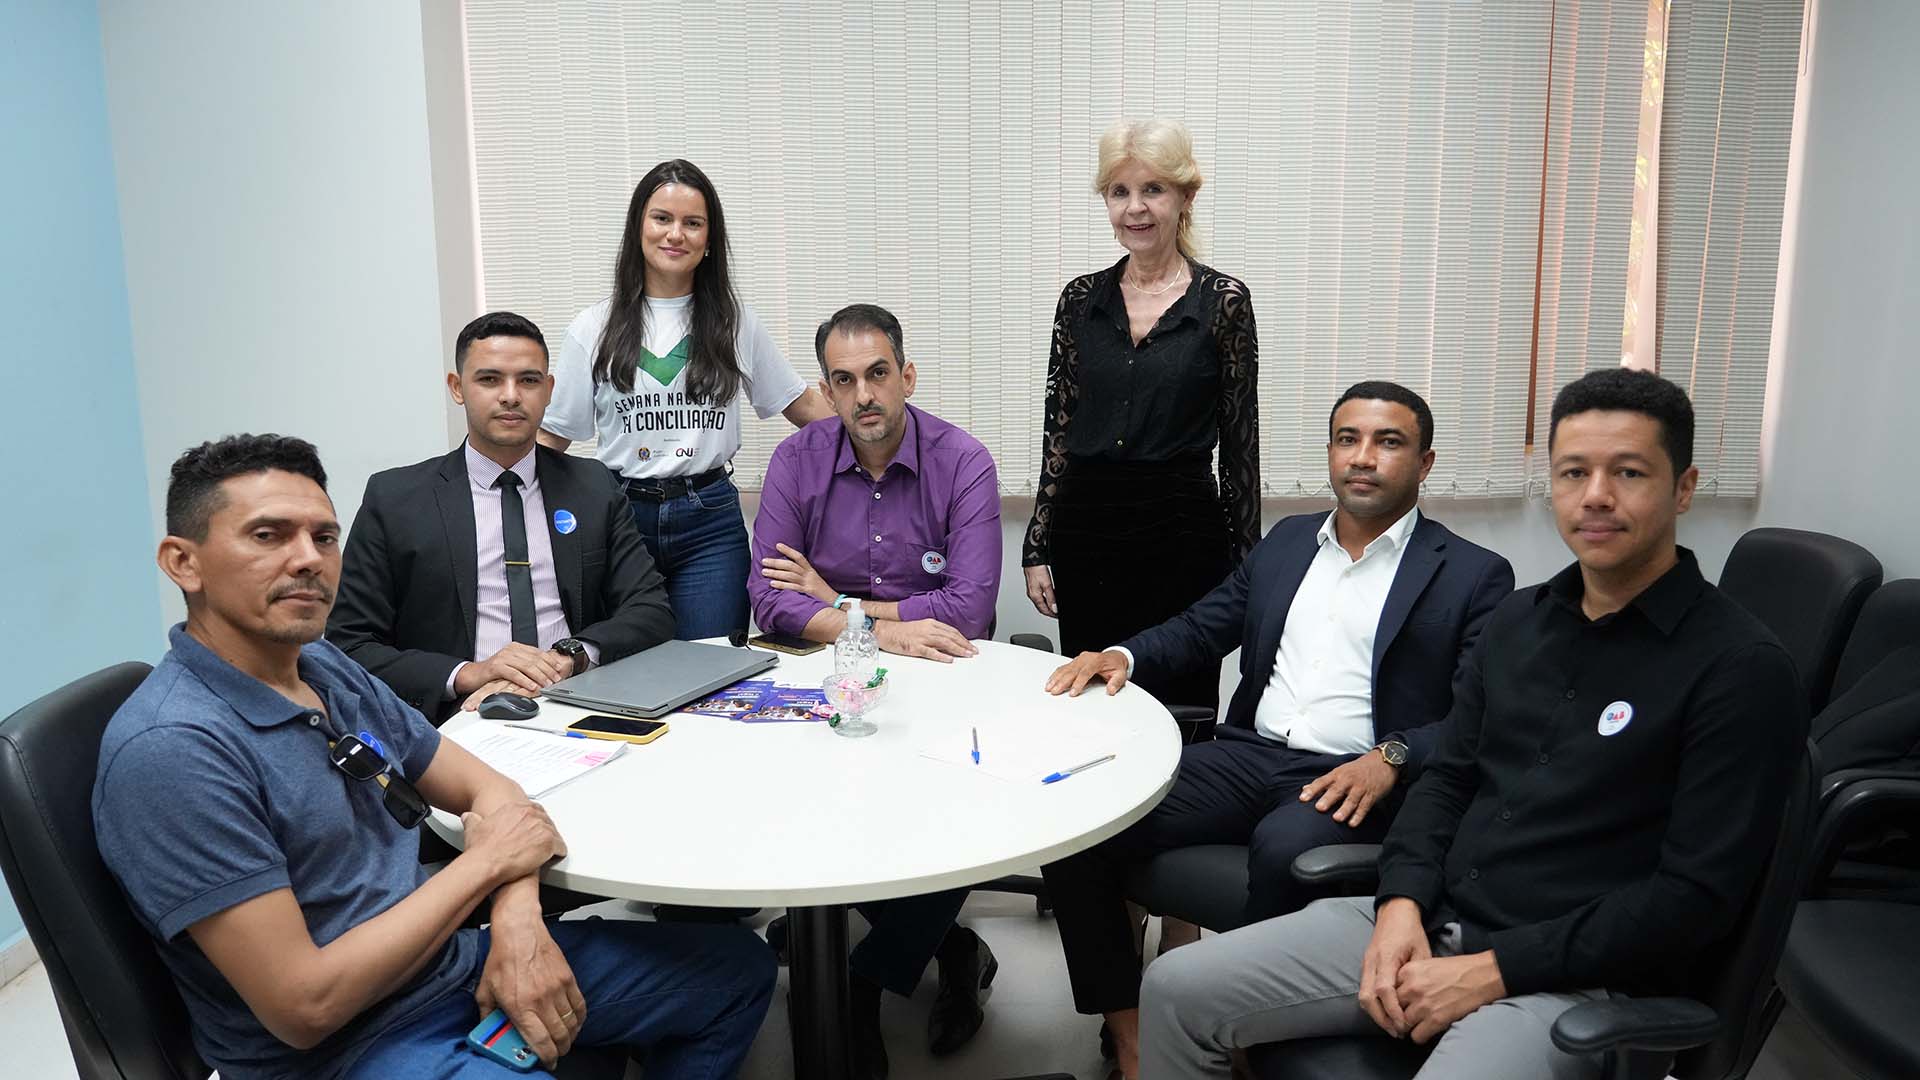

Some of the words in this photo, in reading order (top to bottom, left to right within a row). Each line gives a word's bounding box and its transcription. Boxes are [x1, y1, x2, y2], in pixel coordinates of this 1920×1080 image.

[615, 393, 661, 414] SEMANA
[635, 406, 726, 434] CONCILIAÇÃO
[675, 447, 694, 458] CNJ
[1606, 711, 1625, 721] OAB
